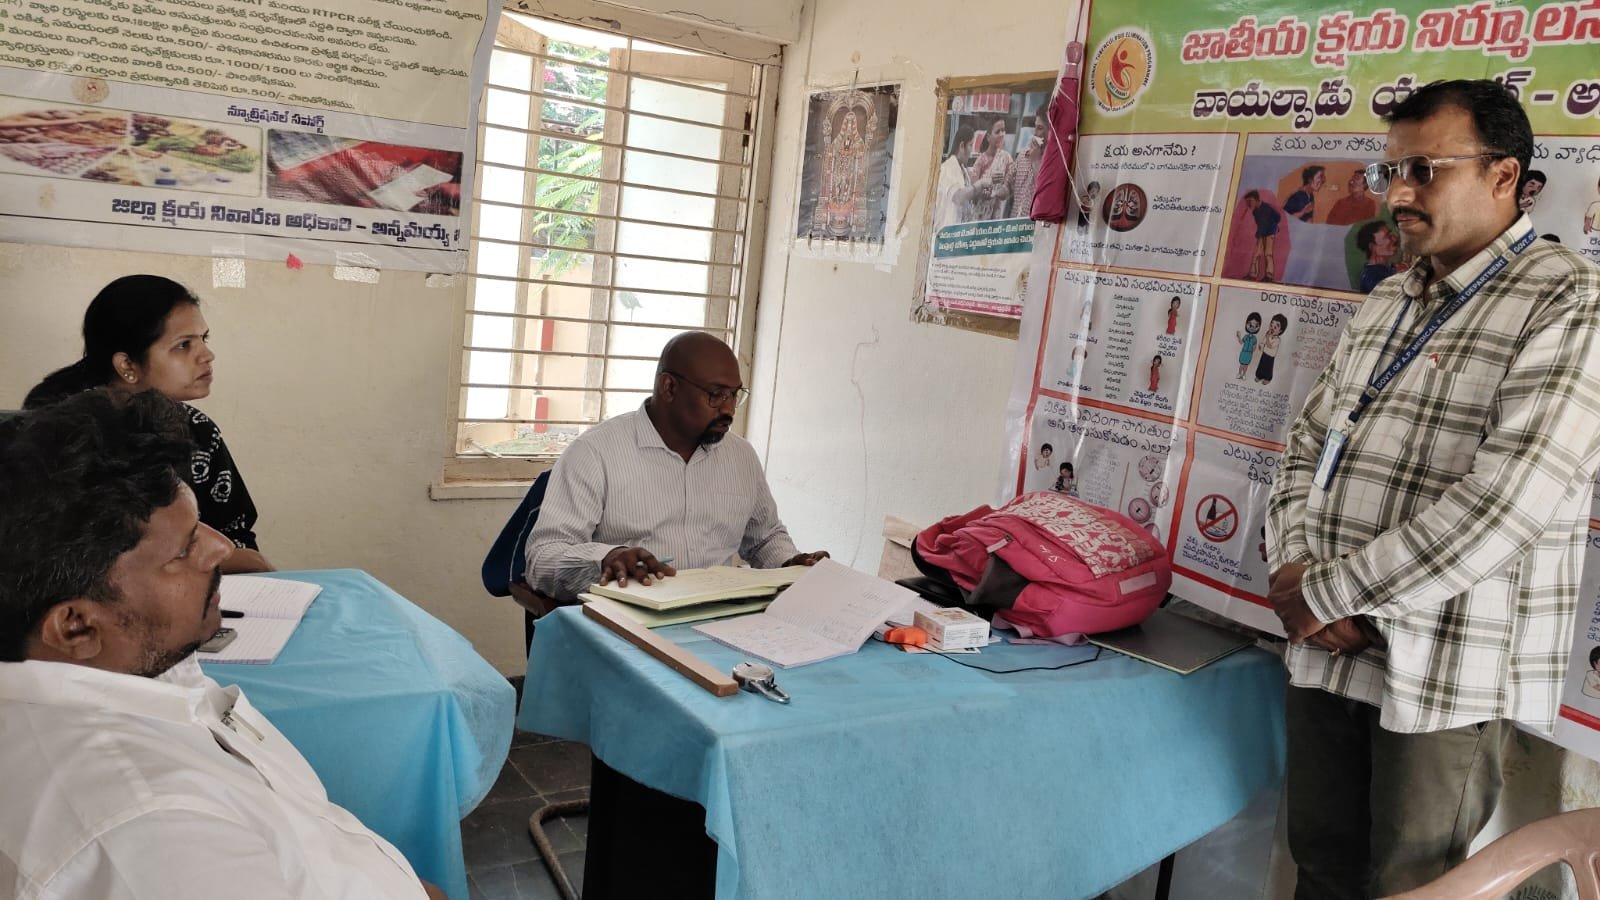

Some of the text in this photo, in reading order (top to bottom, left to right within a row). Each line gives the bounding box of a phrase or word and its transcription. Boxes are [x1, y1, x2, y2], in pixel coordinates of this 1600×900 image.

[312, 8, 356, 22] RTPCR
[1182, 17, 1309, 62] జాతీయ
[1314, 11, 1406, 67] క్షయ
[1193, 79, 1353, 129] వాయల్పాడు
[1103, 144, 1129, 158] క్షయ
[1131, 142, 1188, 157] అనగానేమి
[1272, 135, 1307, 152] క్షయ
[1311, 136, 1343, 151] ఎలా
[112, 198, 157, 222] జిల్లా
[162, 200, 206, 226] క్షయ
[210, 205, 281, 226] నివారణ
[285, 212, 353, 232] అధికారి
[372, 221, 451, 247] అన్నమయ్య
[1260, 291, 1288, 305] DOTS
[1376, 371, 1395, 389] GOVT.
[1393, 362, 1402, 372] OF
[1413, 324, 1438, 352] MEDICAL
[1442, 295, 1466, 320] HEALTH
[1464, 258, 1506, 297] DEPARTMENT
